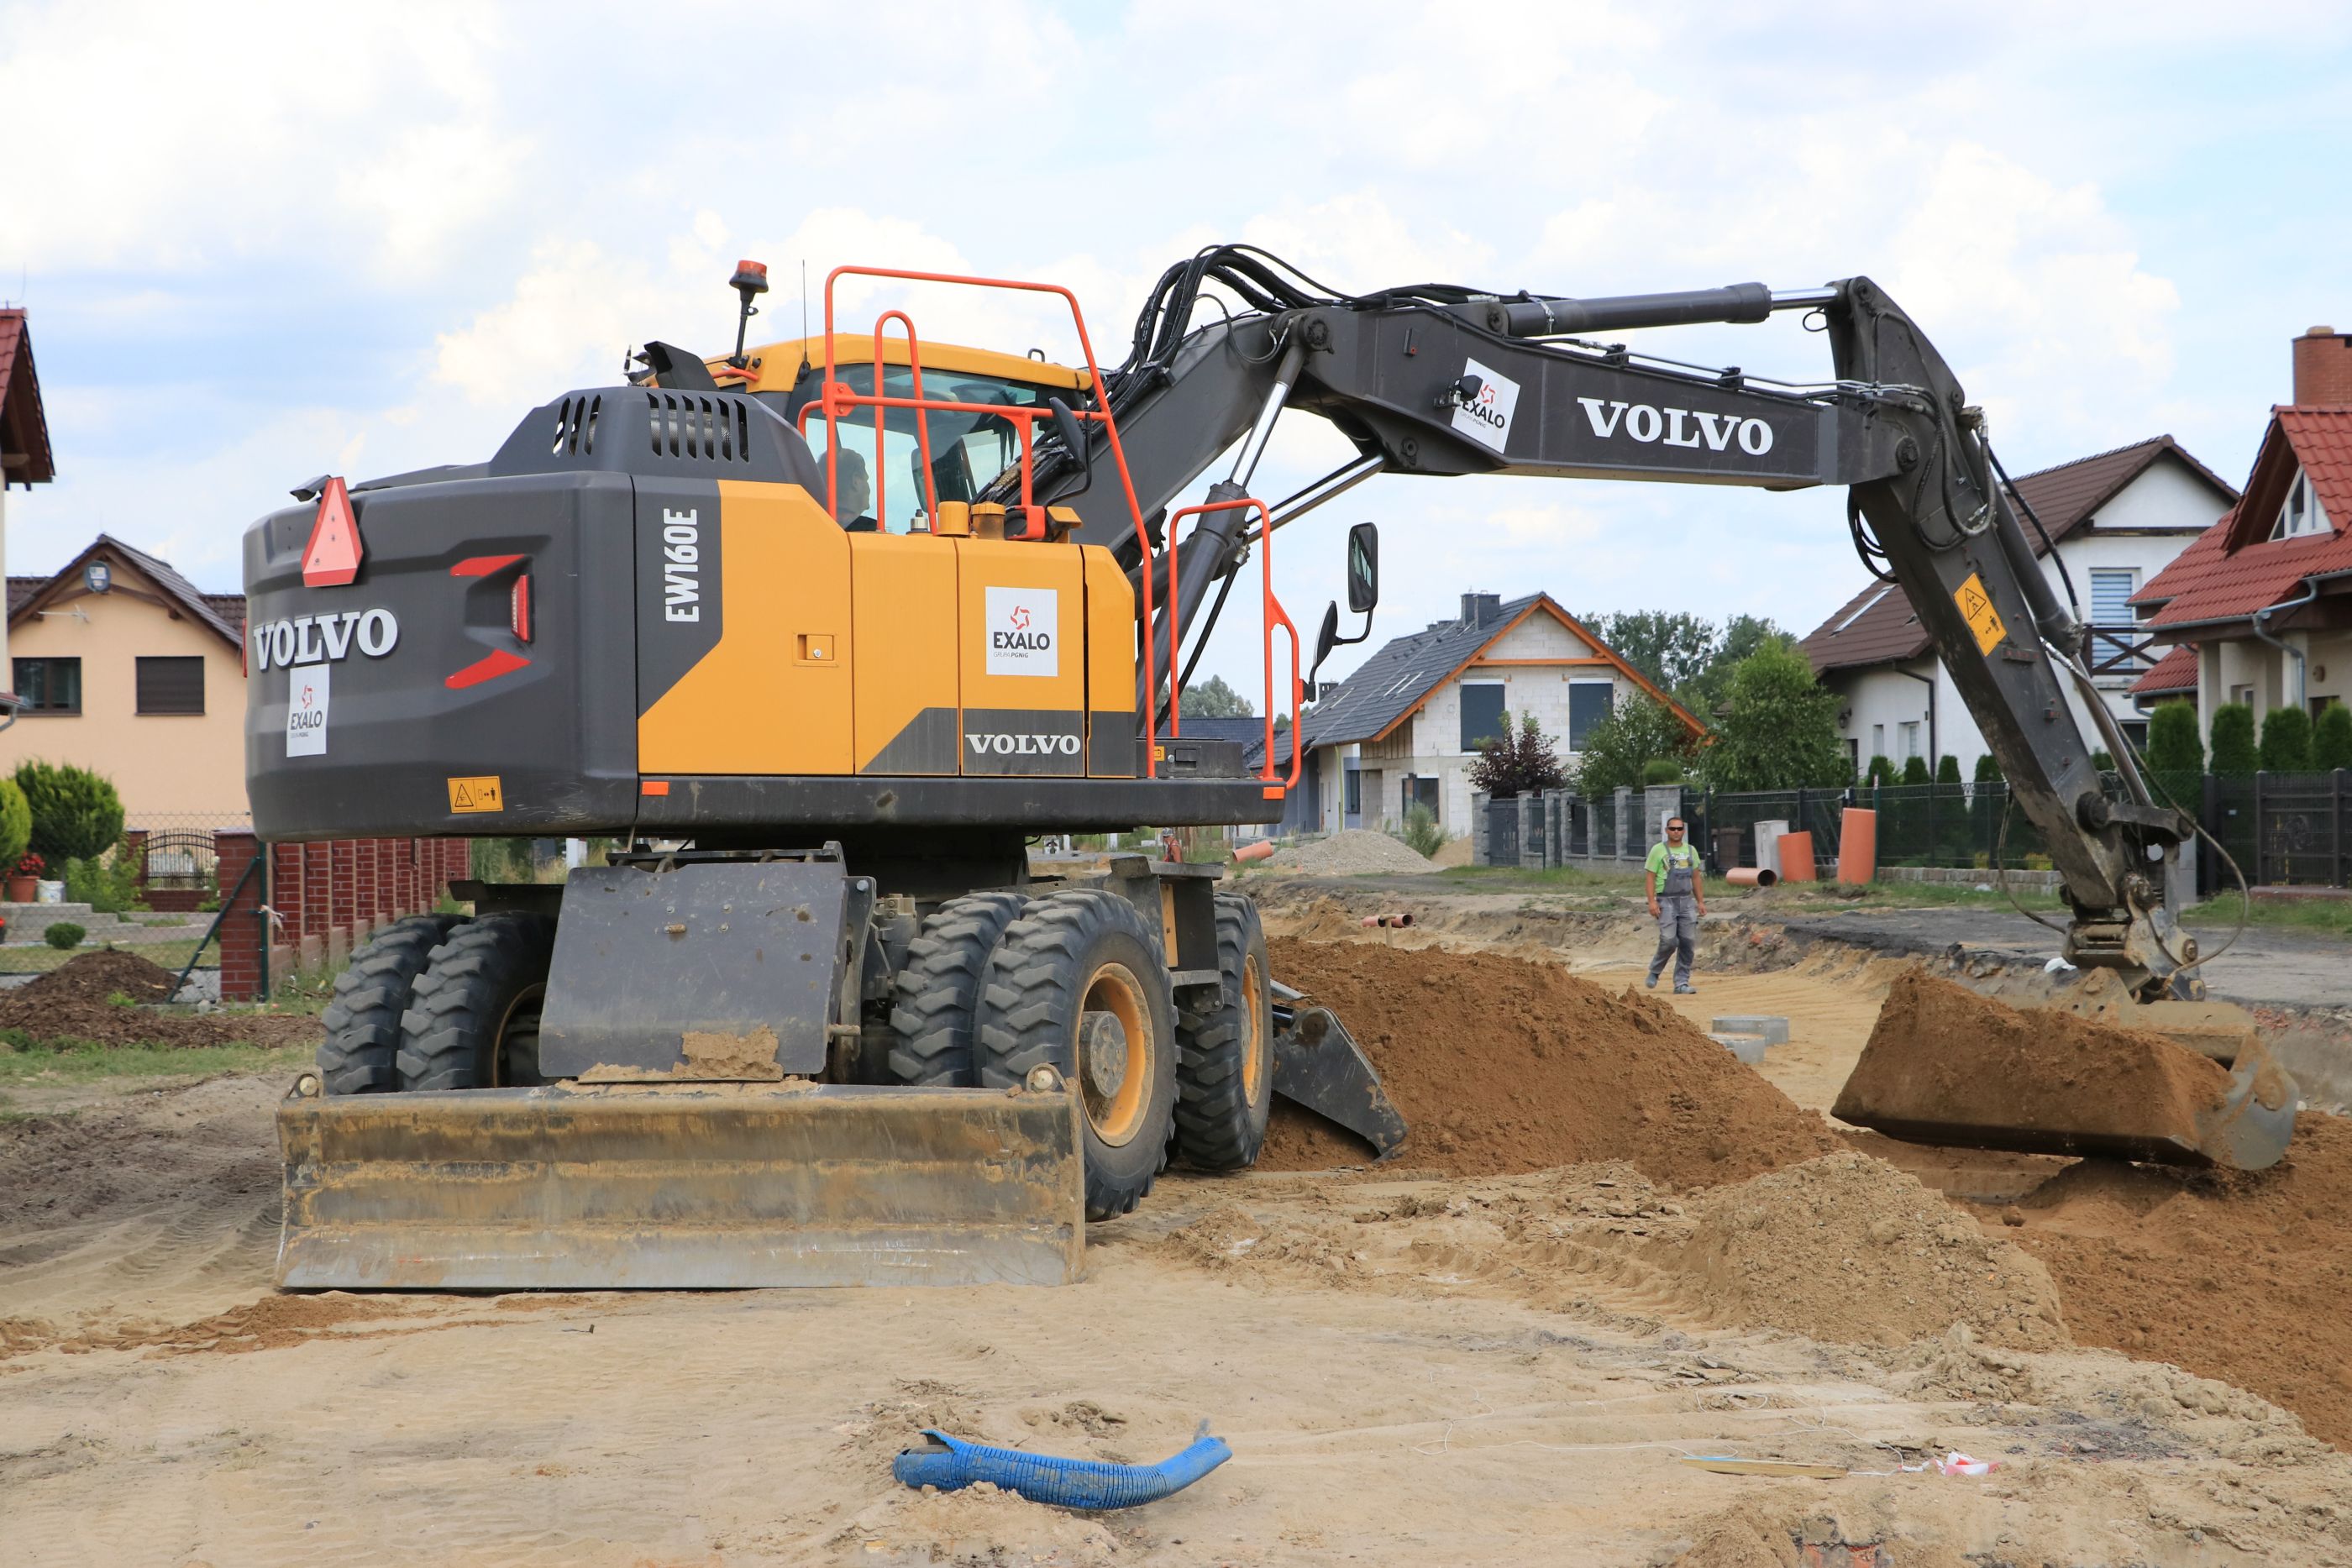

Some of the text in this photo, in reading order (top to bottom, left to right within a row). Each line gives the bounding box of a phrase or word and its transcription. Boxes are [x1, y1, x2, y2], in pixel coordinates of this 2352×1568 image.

[1462, 398, 1505, 428] EXALO
[1577, 396, 1773, 456] VOLVO
[664, 508, 700, 623] EW160E
[254, 608, 398, 671] VOLVO
[993, 632, 1050, 650] EXALO
[290, 710, 323, 731] EXALO
[965, 734, 1081, 755] VOLVO
